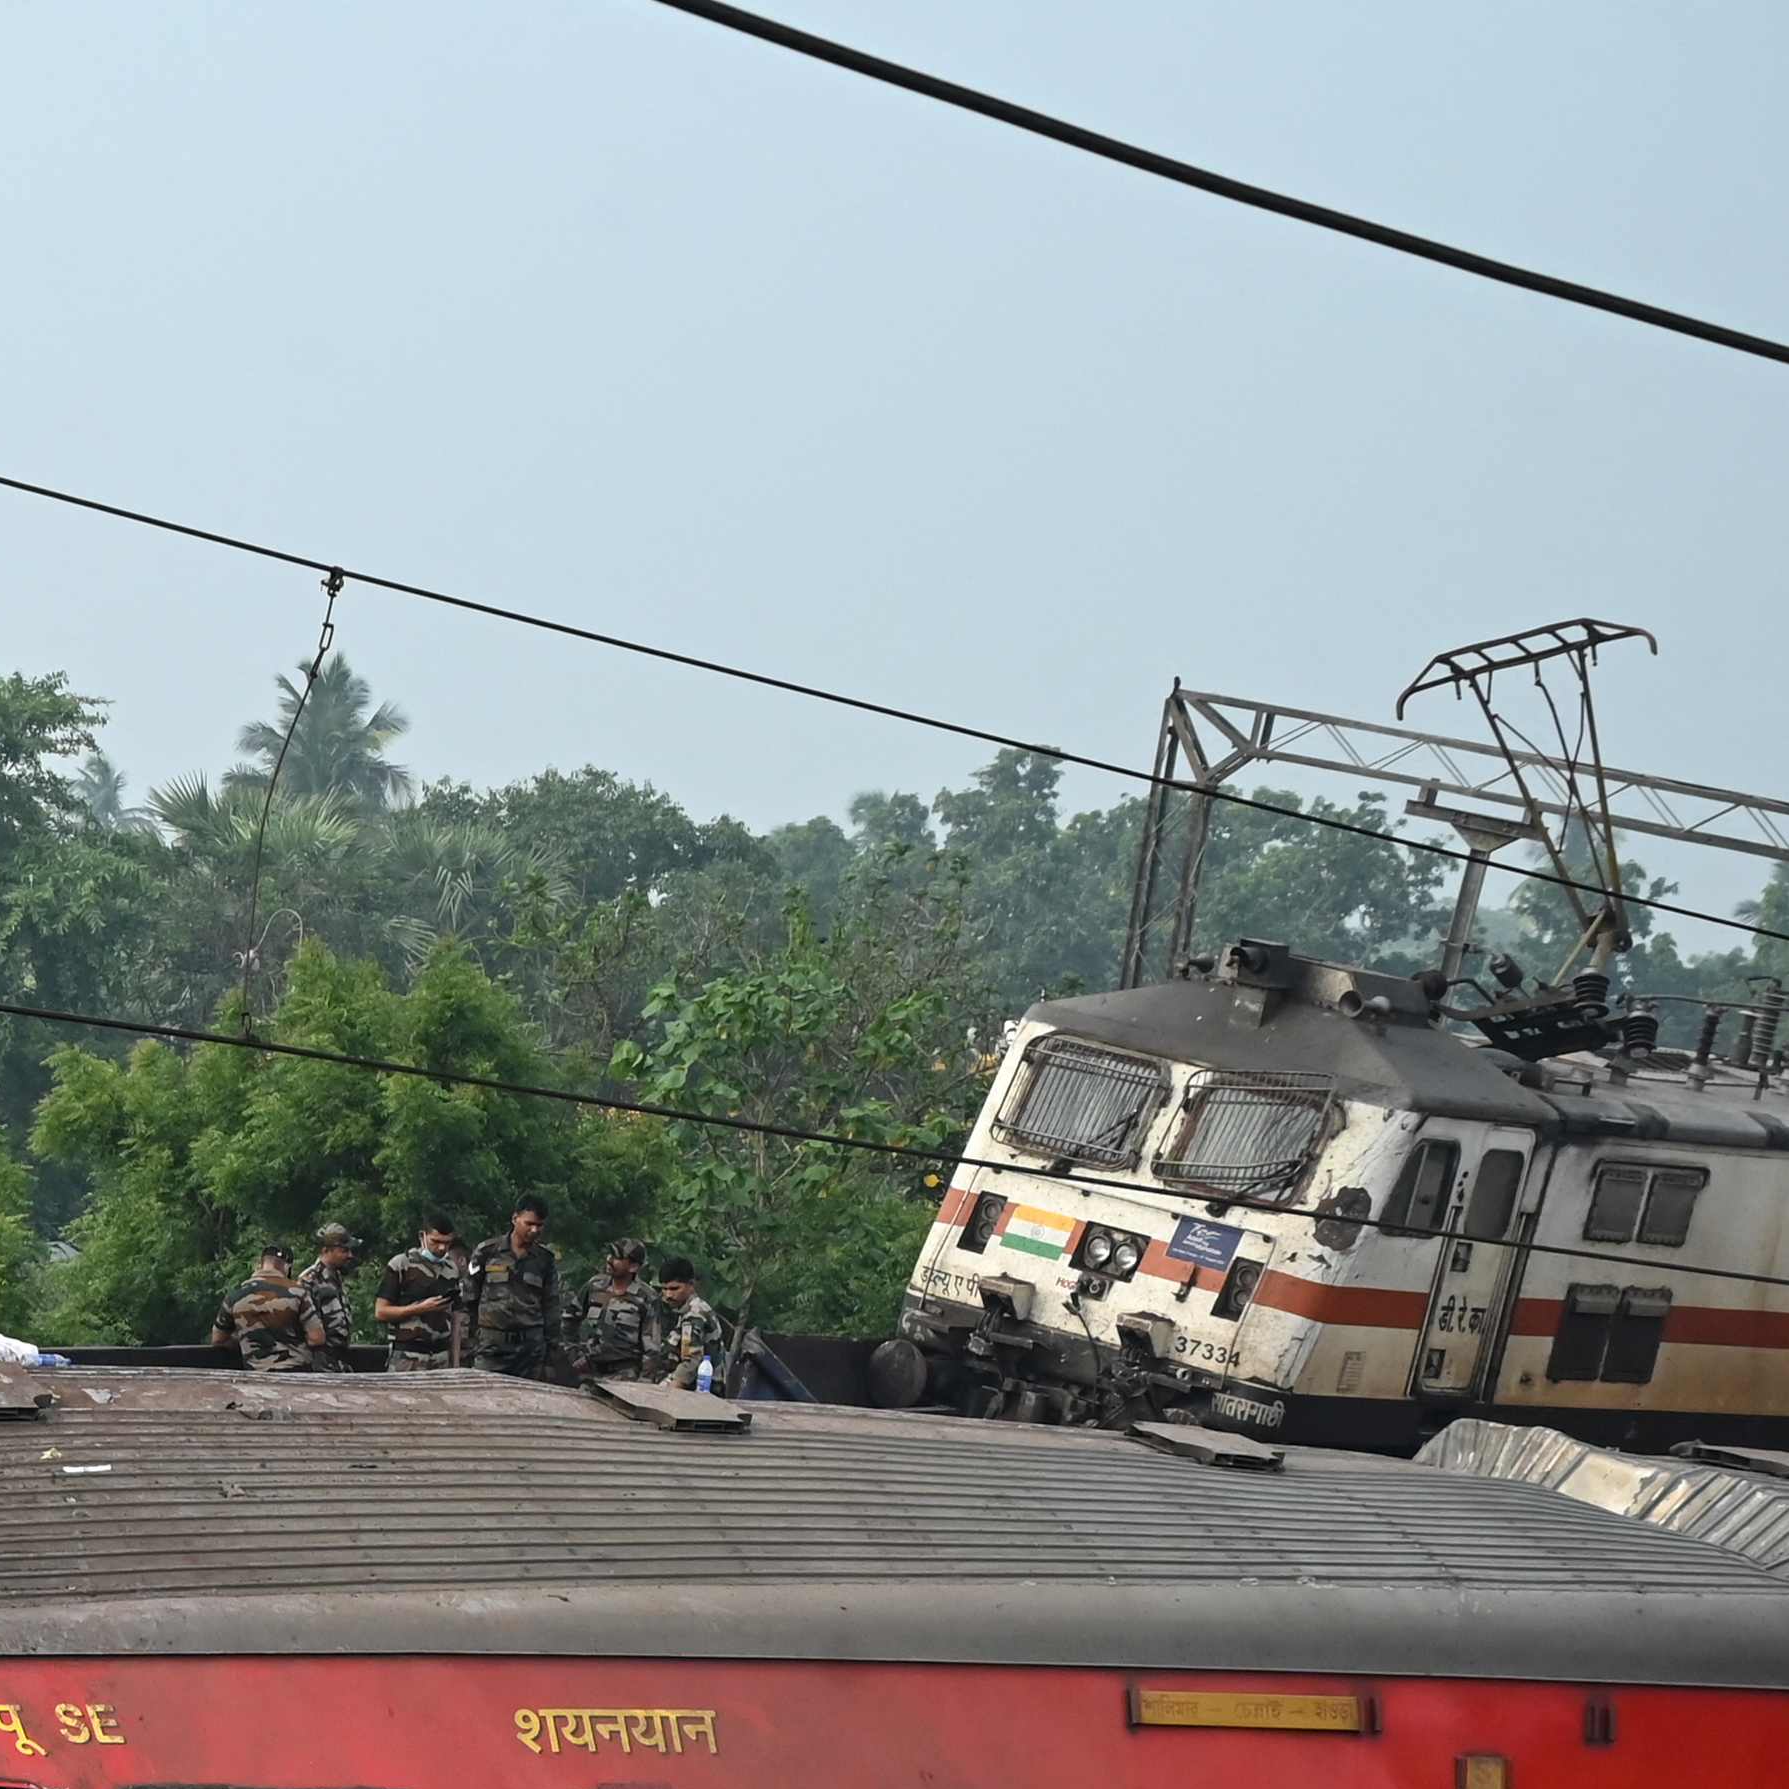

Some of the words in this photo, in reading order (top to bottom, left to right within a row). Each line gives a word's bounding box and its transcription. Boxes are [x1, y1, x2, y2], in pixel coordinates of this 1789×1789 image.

[1174, 1335, 1241, 1368] 37334
[55, 1702, 126, 1745] SE
[514, 1707, 719, 1756] शयनयान
